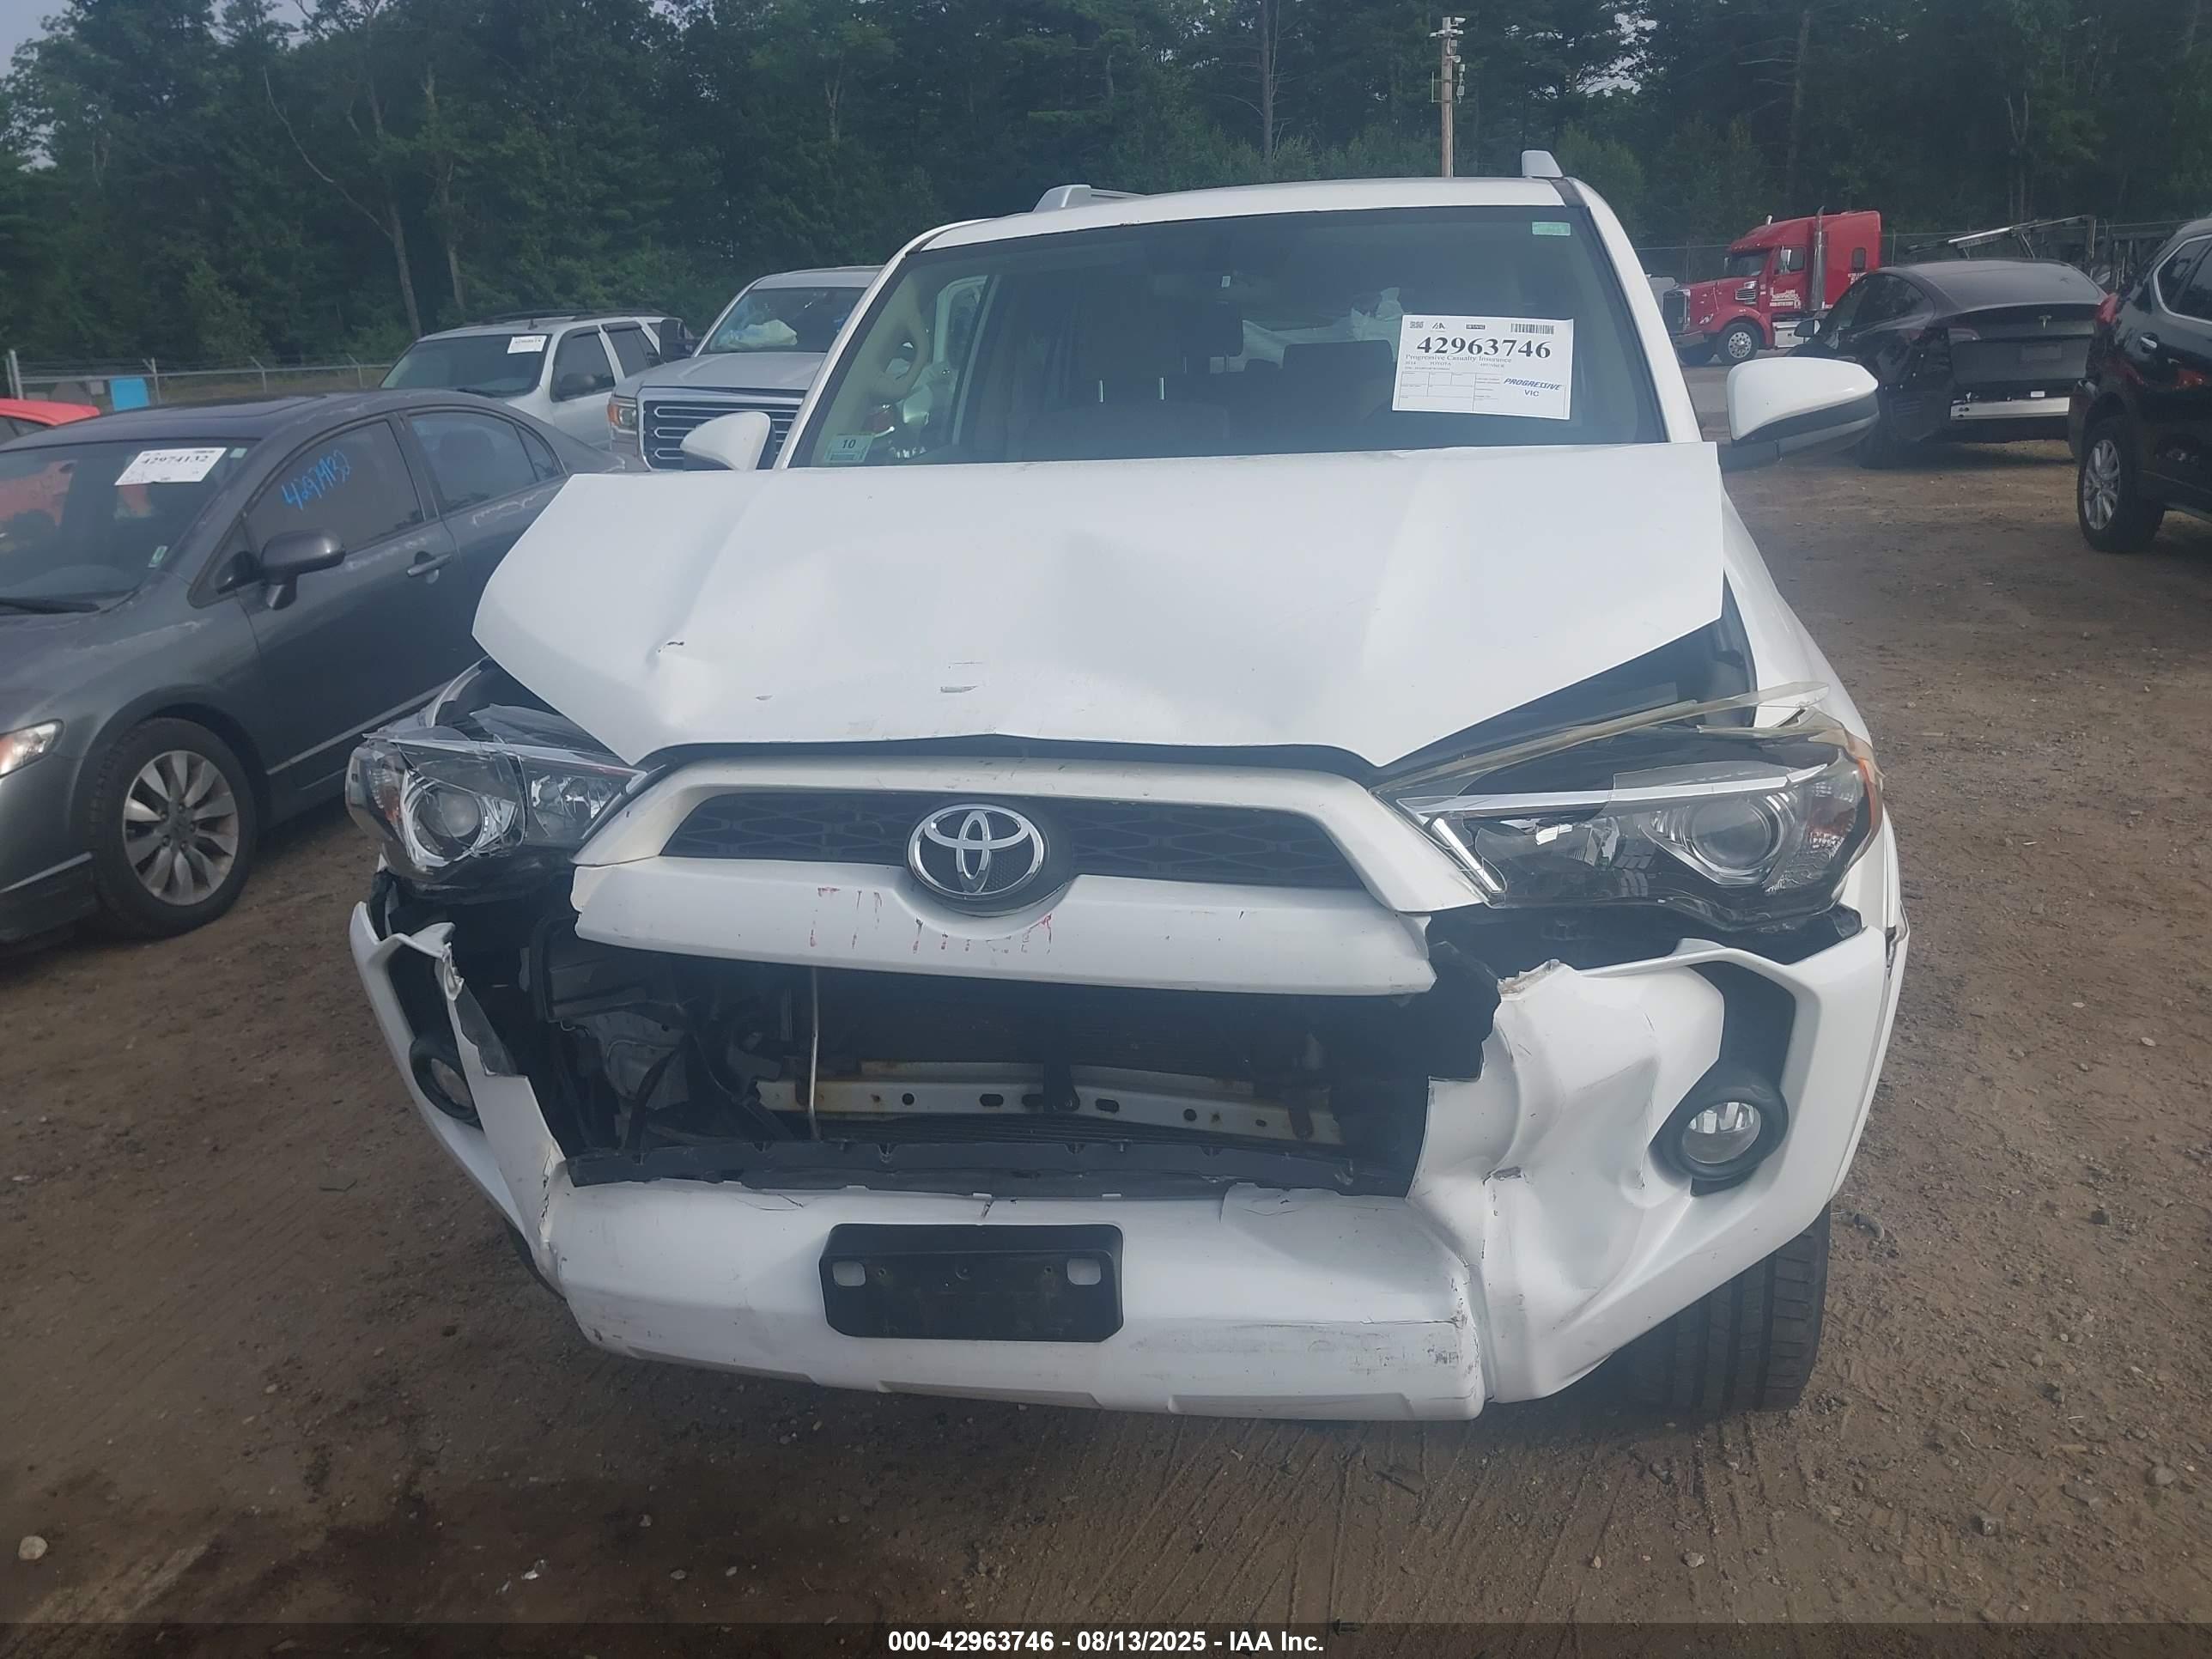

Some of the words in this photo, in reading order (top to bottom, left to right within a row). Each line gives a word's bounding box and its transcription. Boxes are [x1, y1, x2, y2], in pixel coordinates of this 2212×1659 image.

[1416, 336, 1552, 359] 42963746
[1503, 377, 1562, 391] PROGRESSIVE
[842, 439, 857, 449] 10
